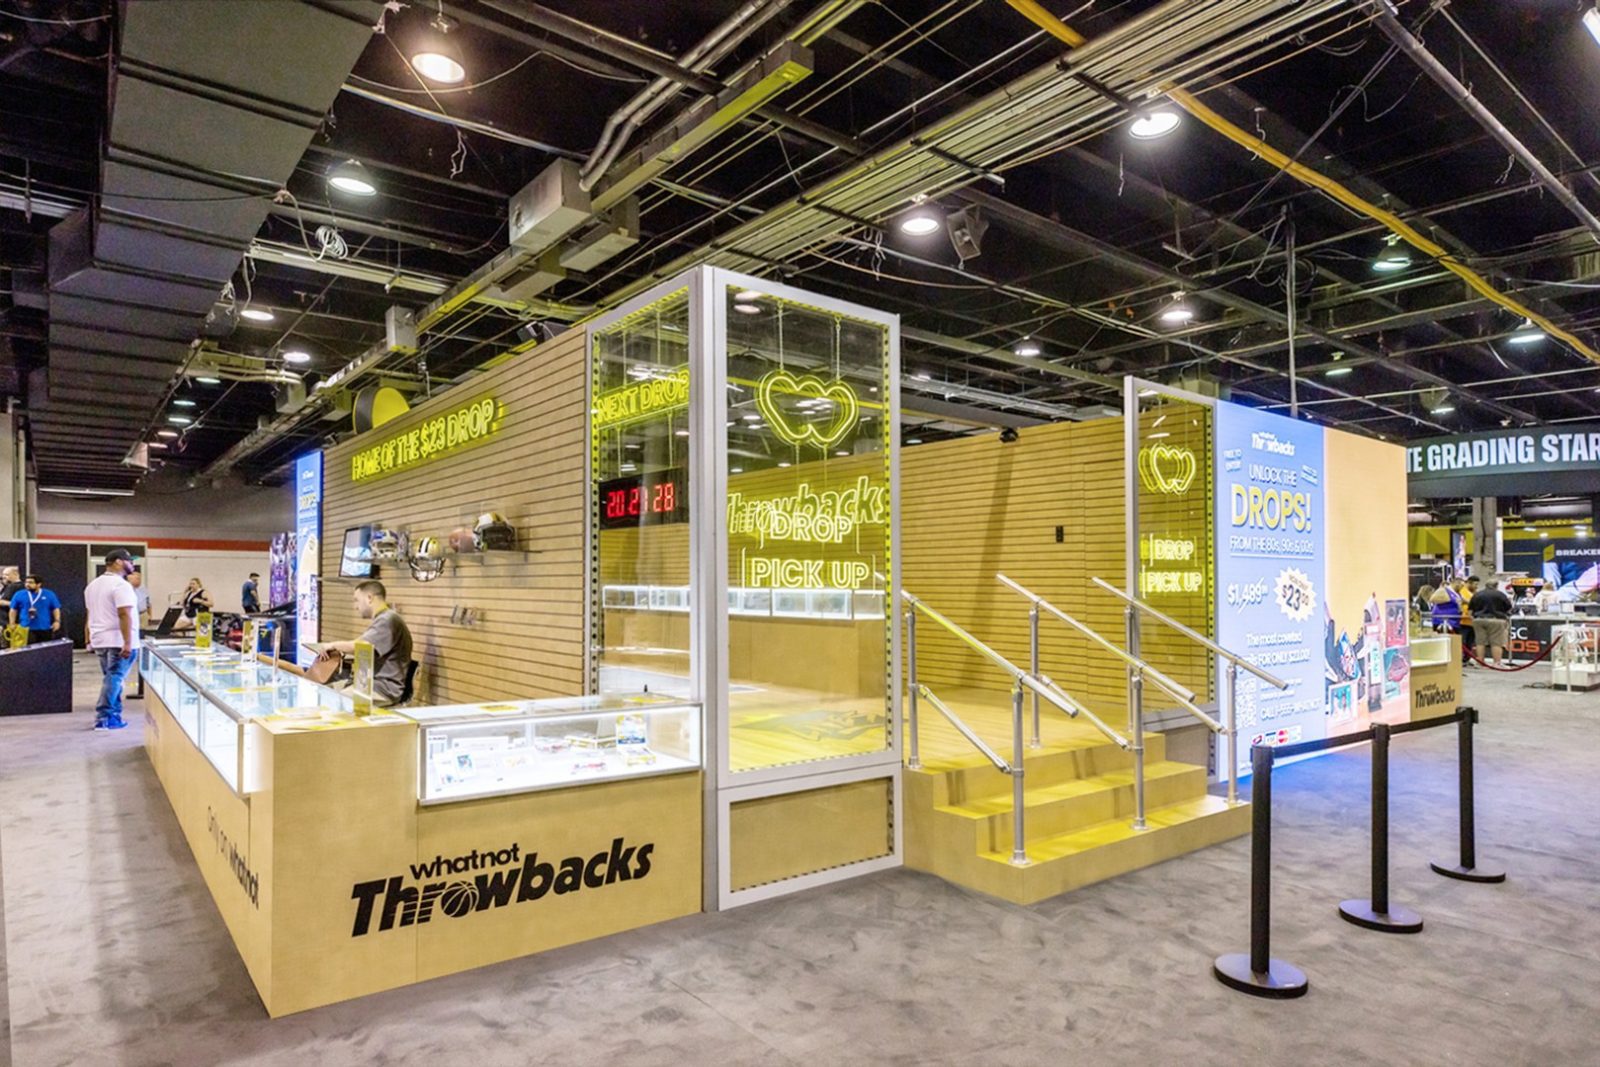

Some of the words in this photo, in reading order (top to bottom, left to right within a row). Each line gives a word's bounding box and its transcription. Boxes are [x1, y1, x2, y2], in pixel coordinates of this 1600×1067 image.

[597, 386, 639, 423] NEXT
[639, 369, 690, 410] DROP
[352, 446, 381, 481] HOME
[381, 439, 396, 470] OF
[397, 429, 420, 465] THE
[420, 416, 446, 459] $23
[447, 398, 495, 447] DROP
[1427, 435, 1535, 473] GRADING
[1542, 432, 1600, 463] STAR
[1248, 464, 1281, 485] UNLOCK
[1282, 470, 1297, 487] THE
[1231, 483, 1312, 533] DROPS!
[770, 510, 853, 543] DROP
[1154, 539, 1194, 560] DROP
[1555, 548, 1600, 556] BREAKE
[751, 557, 825, 588] PICK
[832, 561, 870, 589] UP
[1146, 571, 1181, 592] PICK
[1183, 571, 1203, 592] UP
[410, 842, 521, 880] whatnot
[350, 837, 655, 938] Throwbacks
